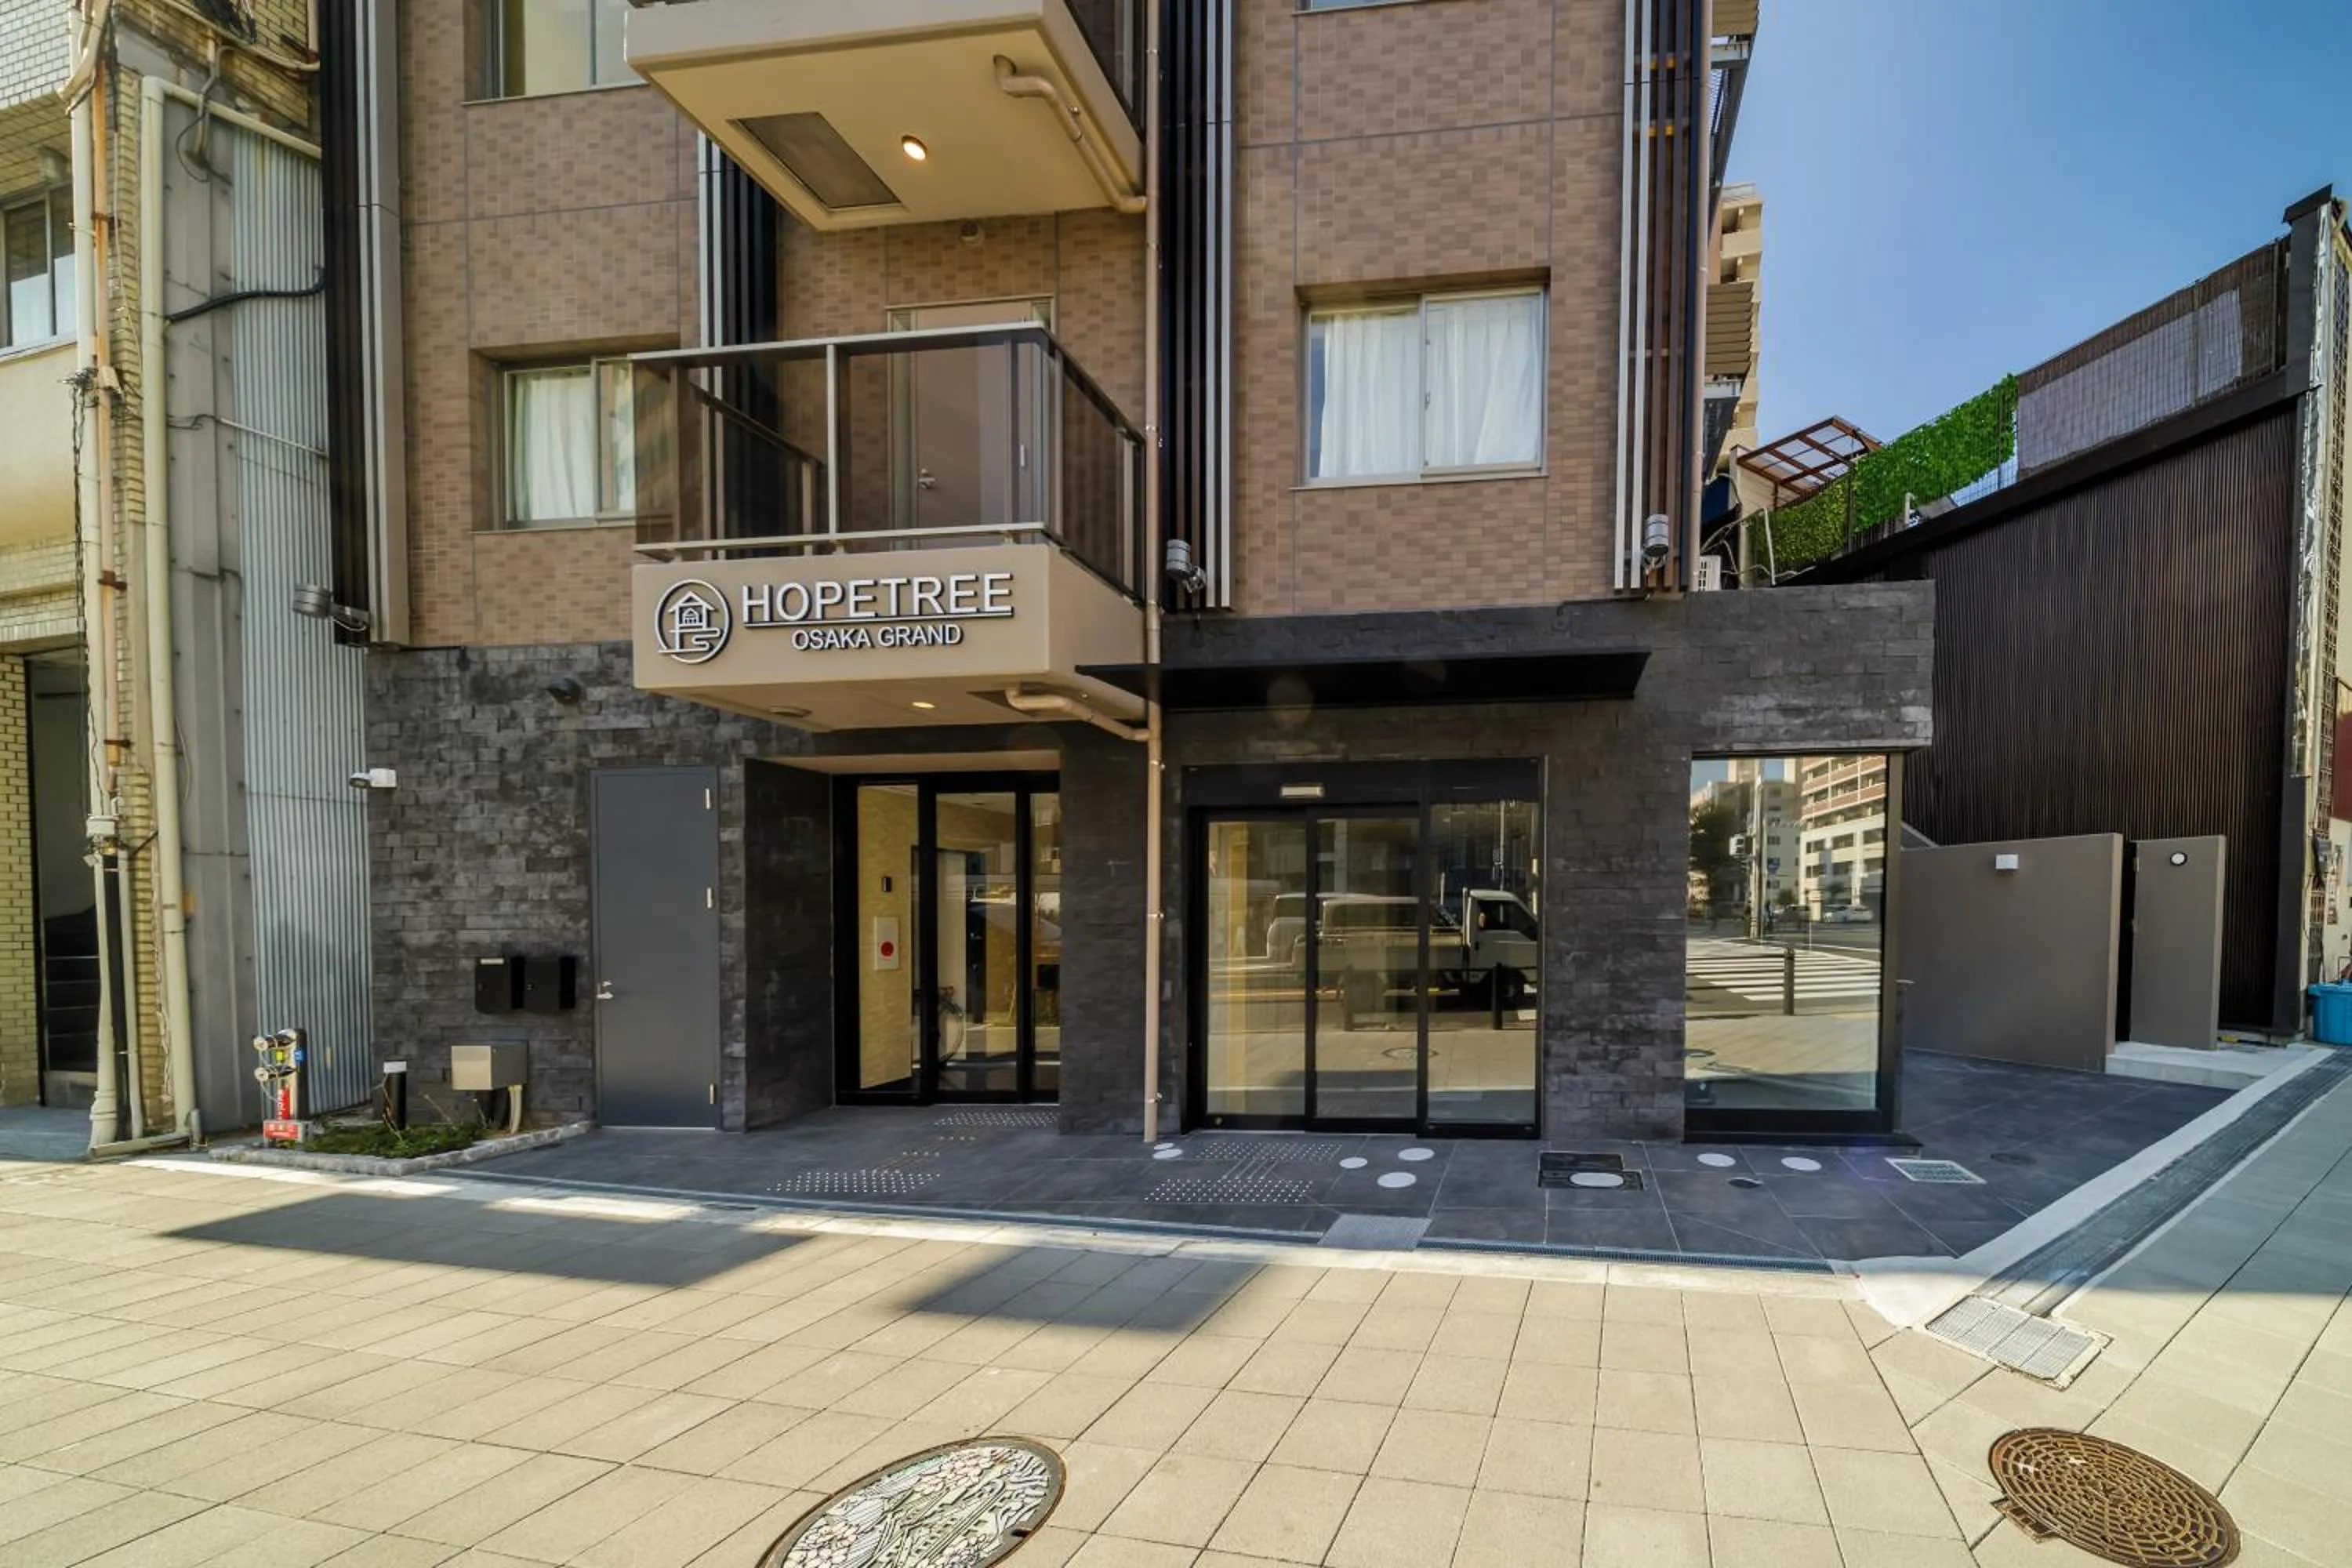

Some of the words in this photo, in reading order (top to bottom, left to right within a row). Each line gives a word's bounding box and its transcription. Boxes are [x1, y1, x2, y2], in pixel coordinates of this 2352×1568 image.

[742, 572, 1014, 622] HOPETREE
[791, 628, 873, 652] OSAKA
[877, 623, 962, 647] GRAND
